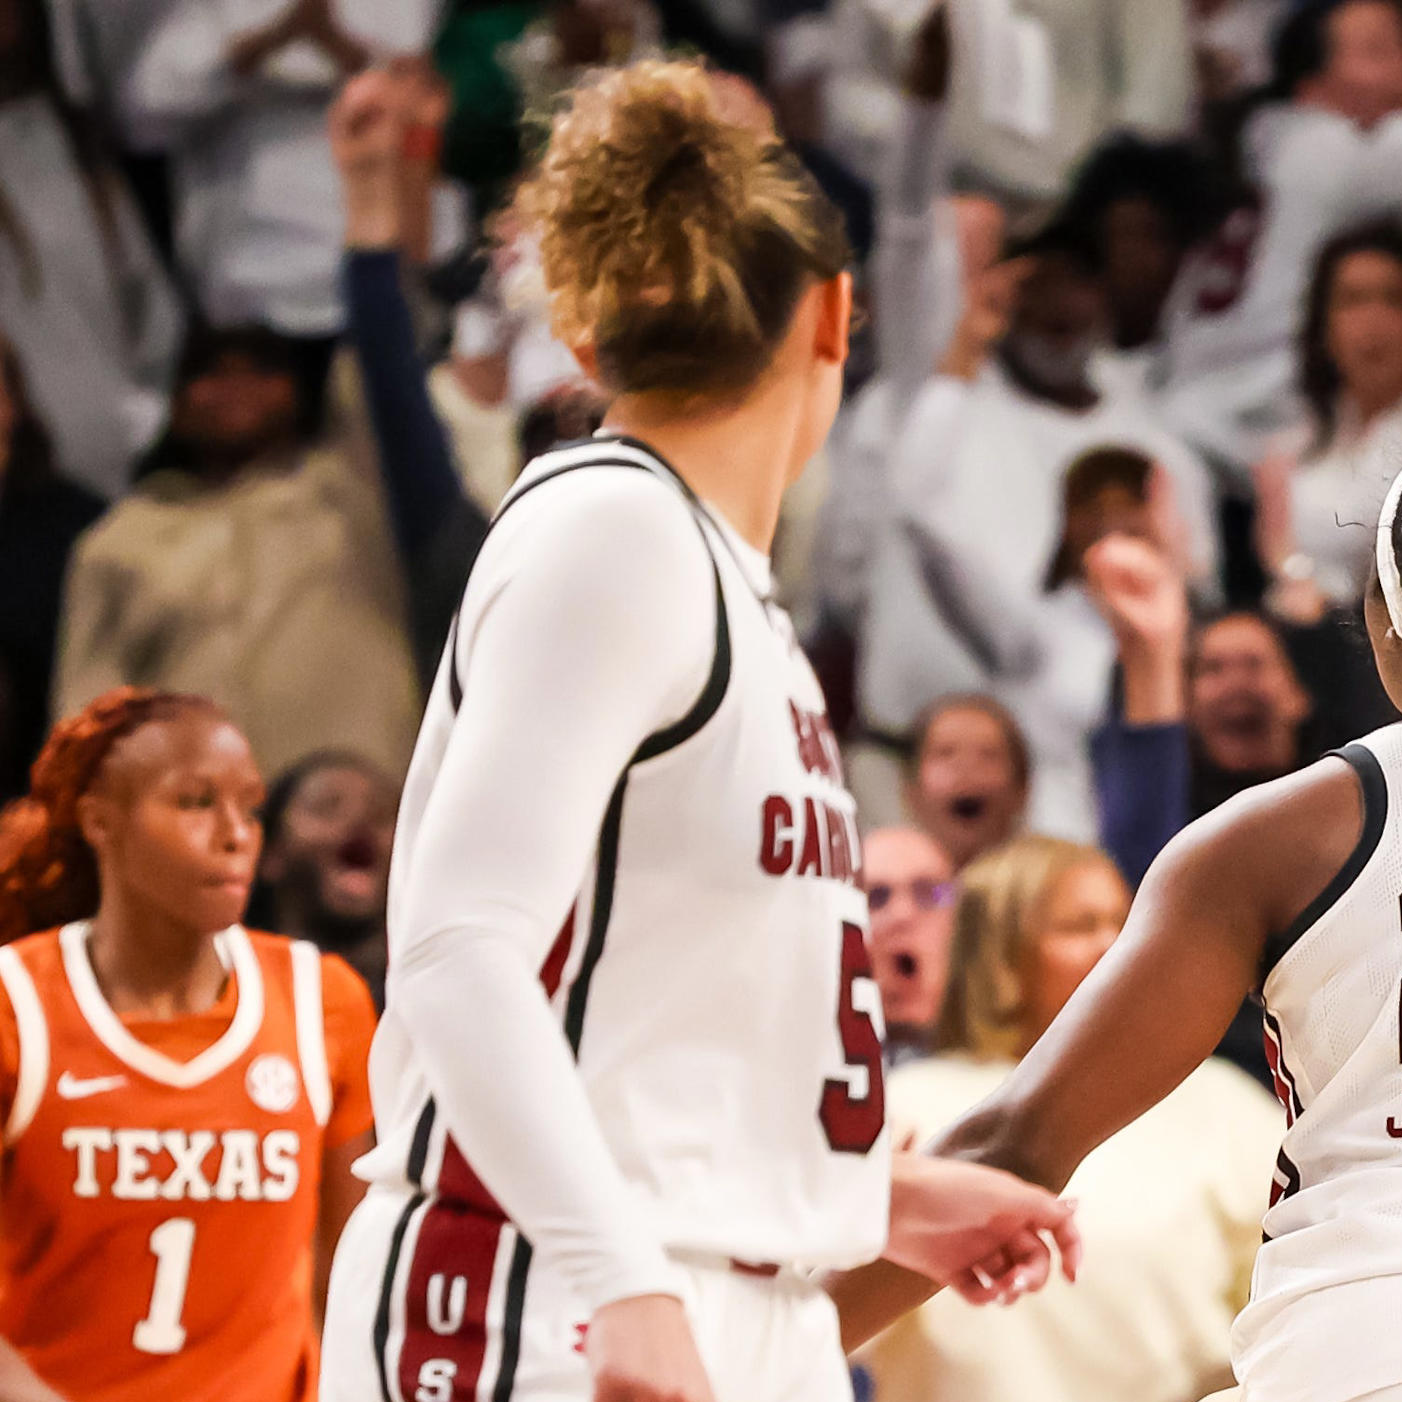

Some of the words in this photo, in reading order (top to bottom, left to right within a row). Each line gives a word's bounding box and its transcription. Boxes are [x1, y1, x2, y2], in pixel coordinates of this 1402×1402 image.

[818, 920, 885, 1154] 5
[61, 1126, 300, 1202] TEXAS
[132, 1216, 197, 1355] 1
